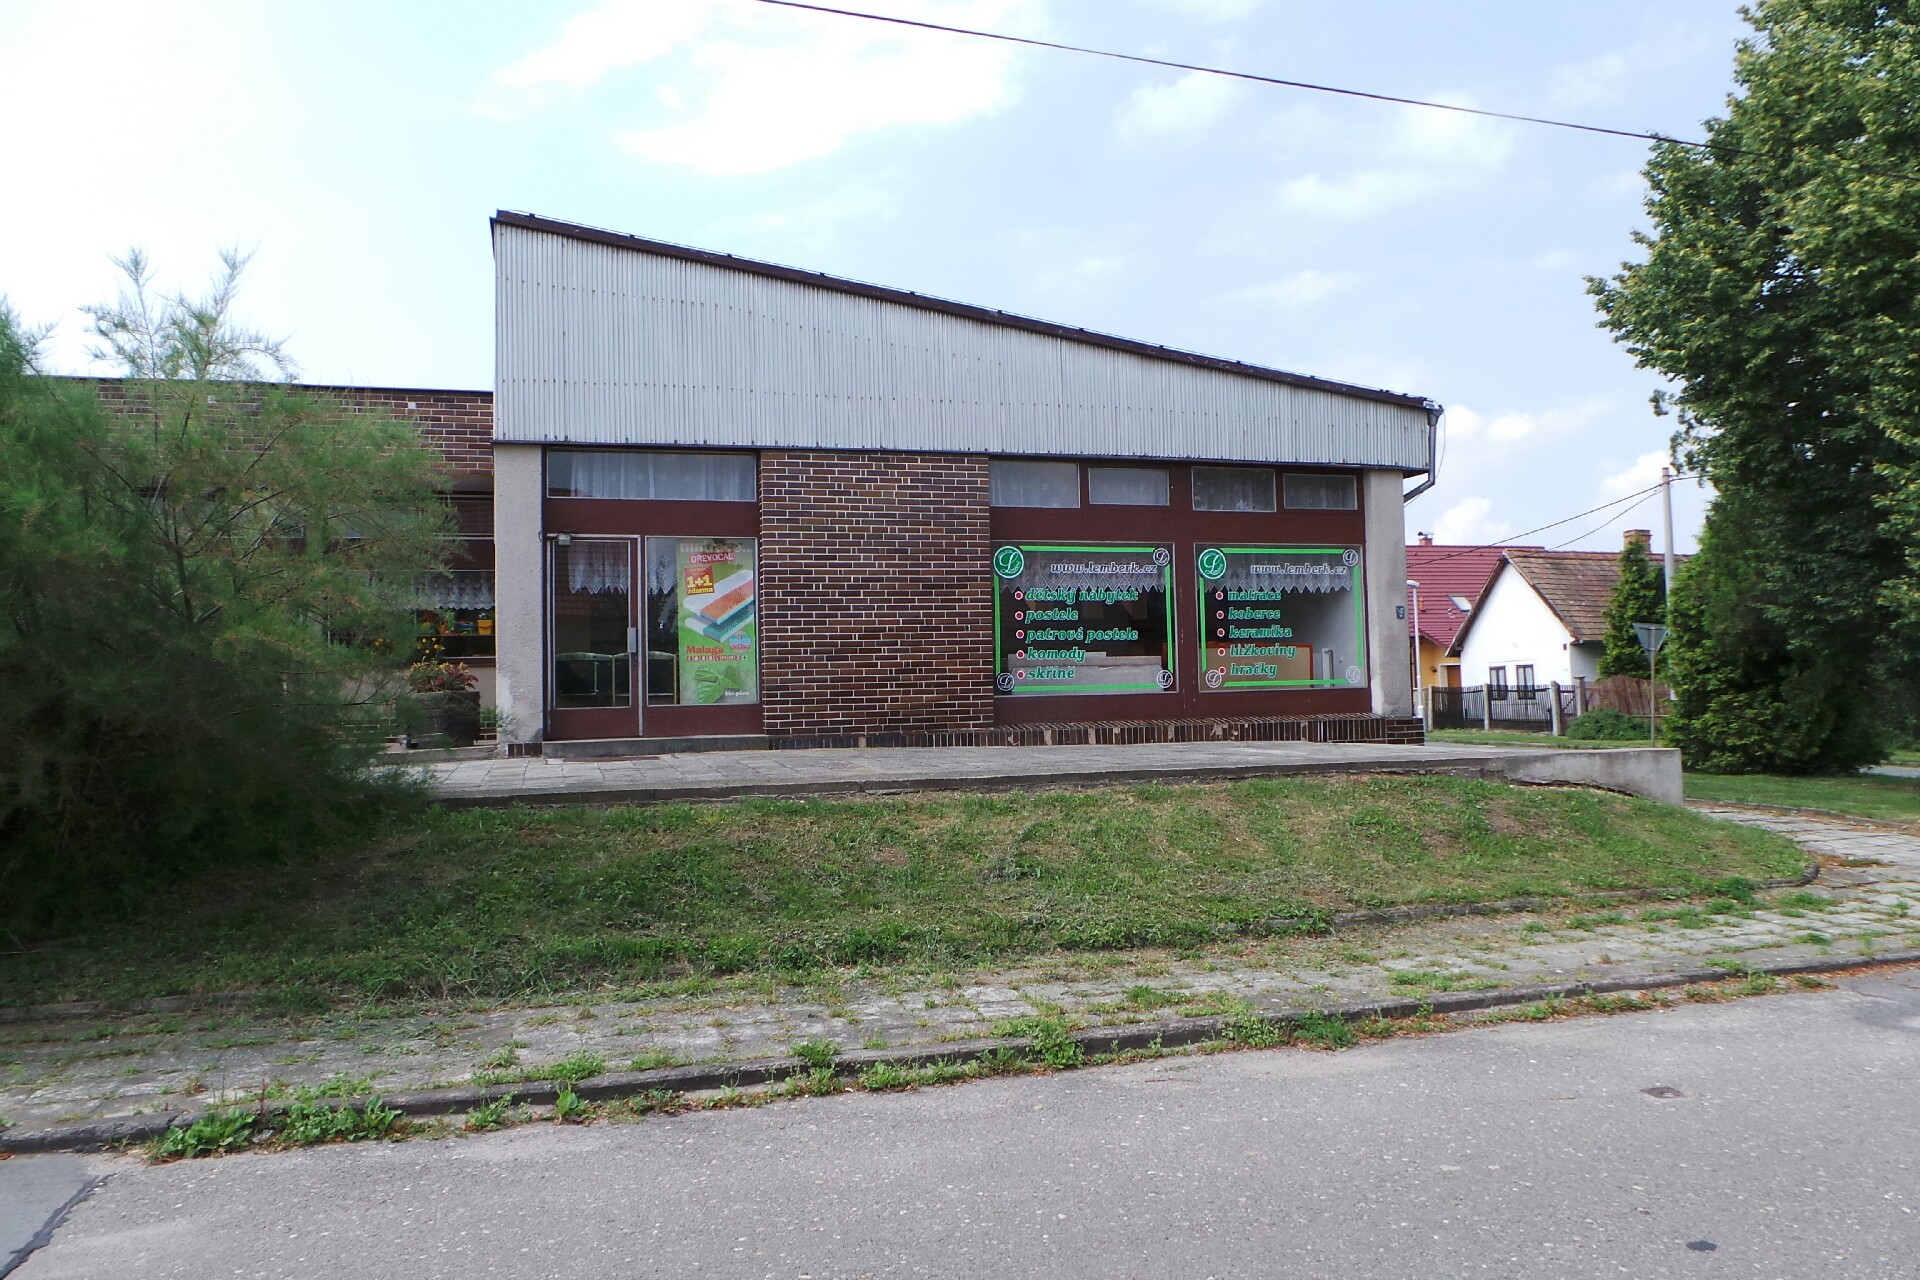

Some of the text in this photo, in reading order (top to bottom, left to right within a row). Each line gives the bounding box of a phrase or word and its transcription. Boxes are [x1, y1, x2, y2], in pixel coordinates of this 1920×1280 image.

[690, 552, 734, 563] DREVOCAL
[1050, 562, 1157, 574] www.lemberk.cz
[1250, 563, 1347, 575] www.lemberk.cz
[687, 575, 712, 588] 1+1
[1025, 588, 1139, 604] dětský nábytek
[1227, 589, 1282, 601] matrace
[1025, 607, 1079, 624] postele
[1228, 607, 1281, 620] koberce
[1025, 627, 1139, 644] patrové postele
[1229, 625, 1293, 638] keramika
[1027, 647, 1086, 663] komody
[1027, 665, 1076, 680] skříně
[1230, 662, 1277, 678] hračky
